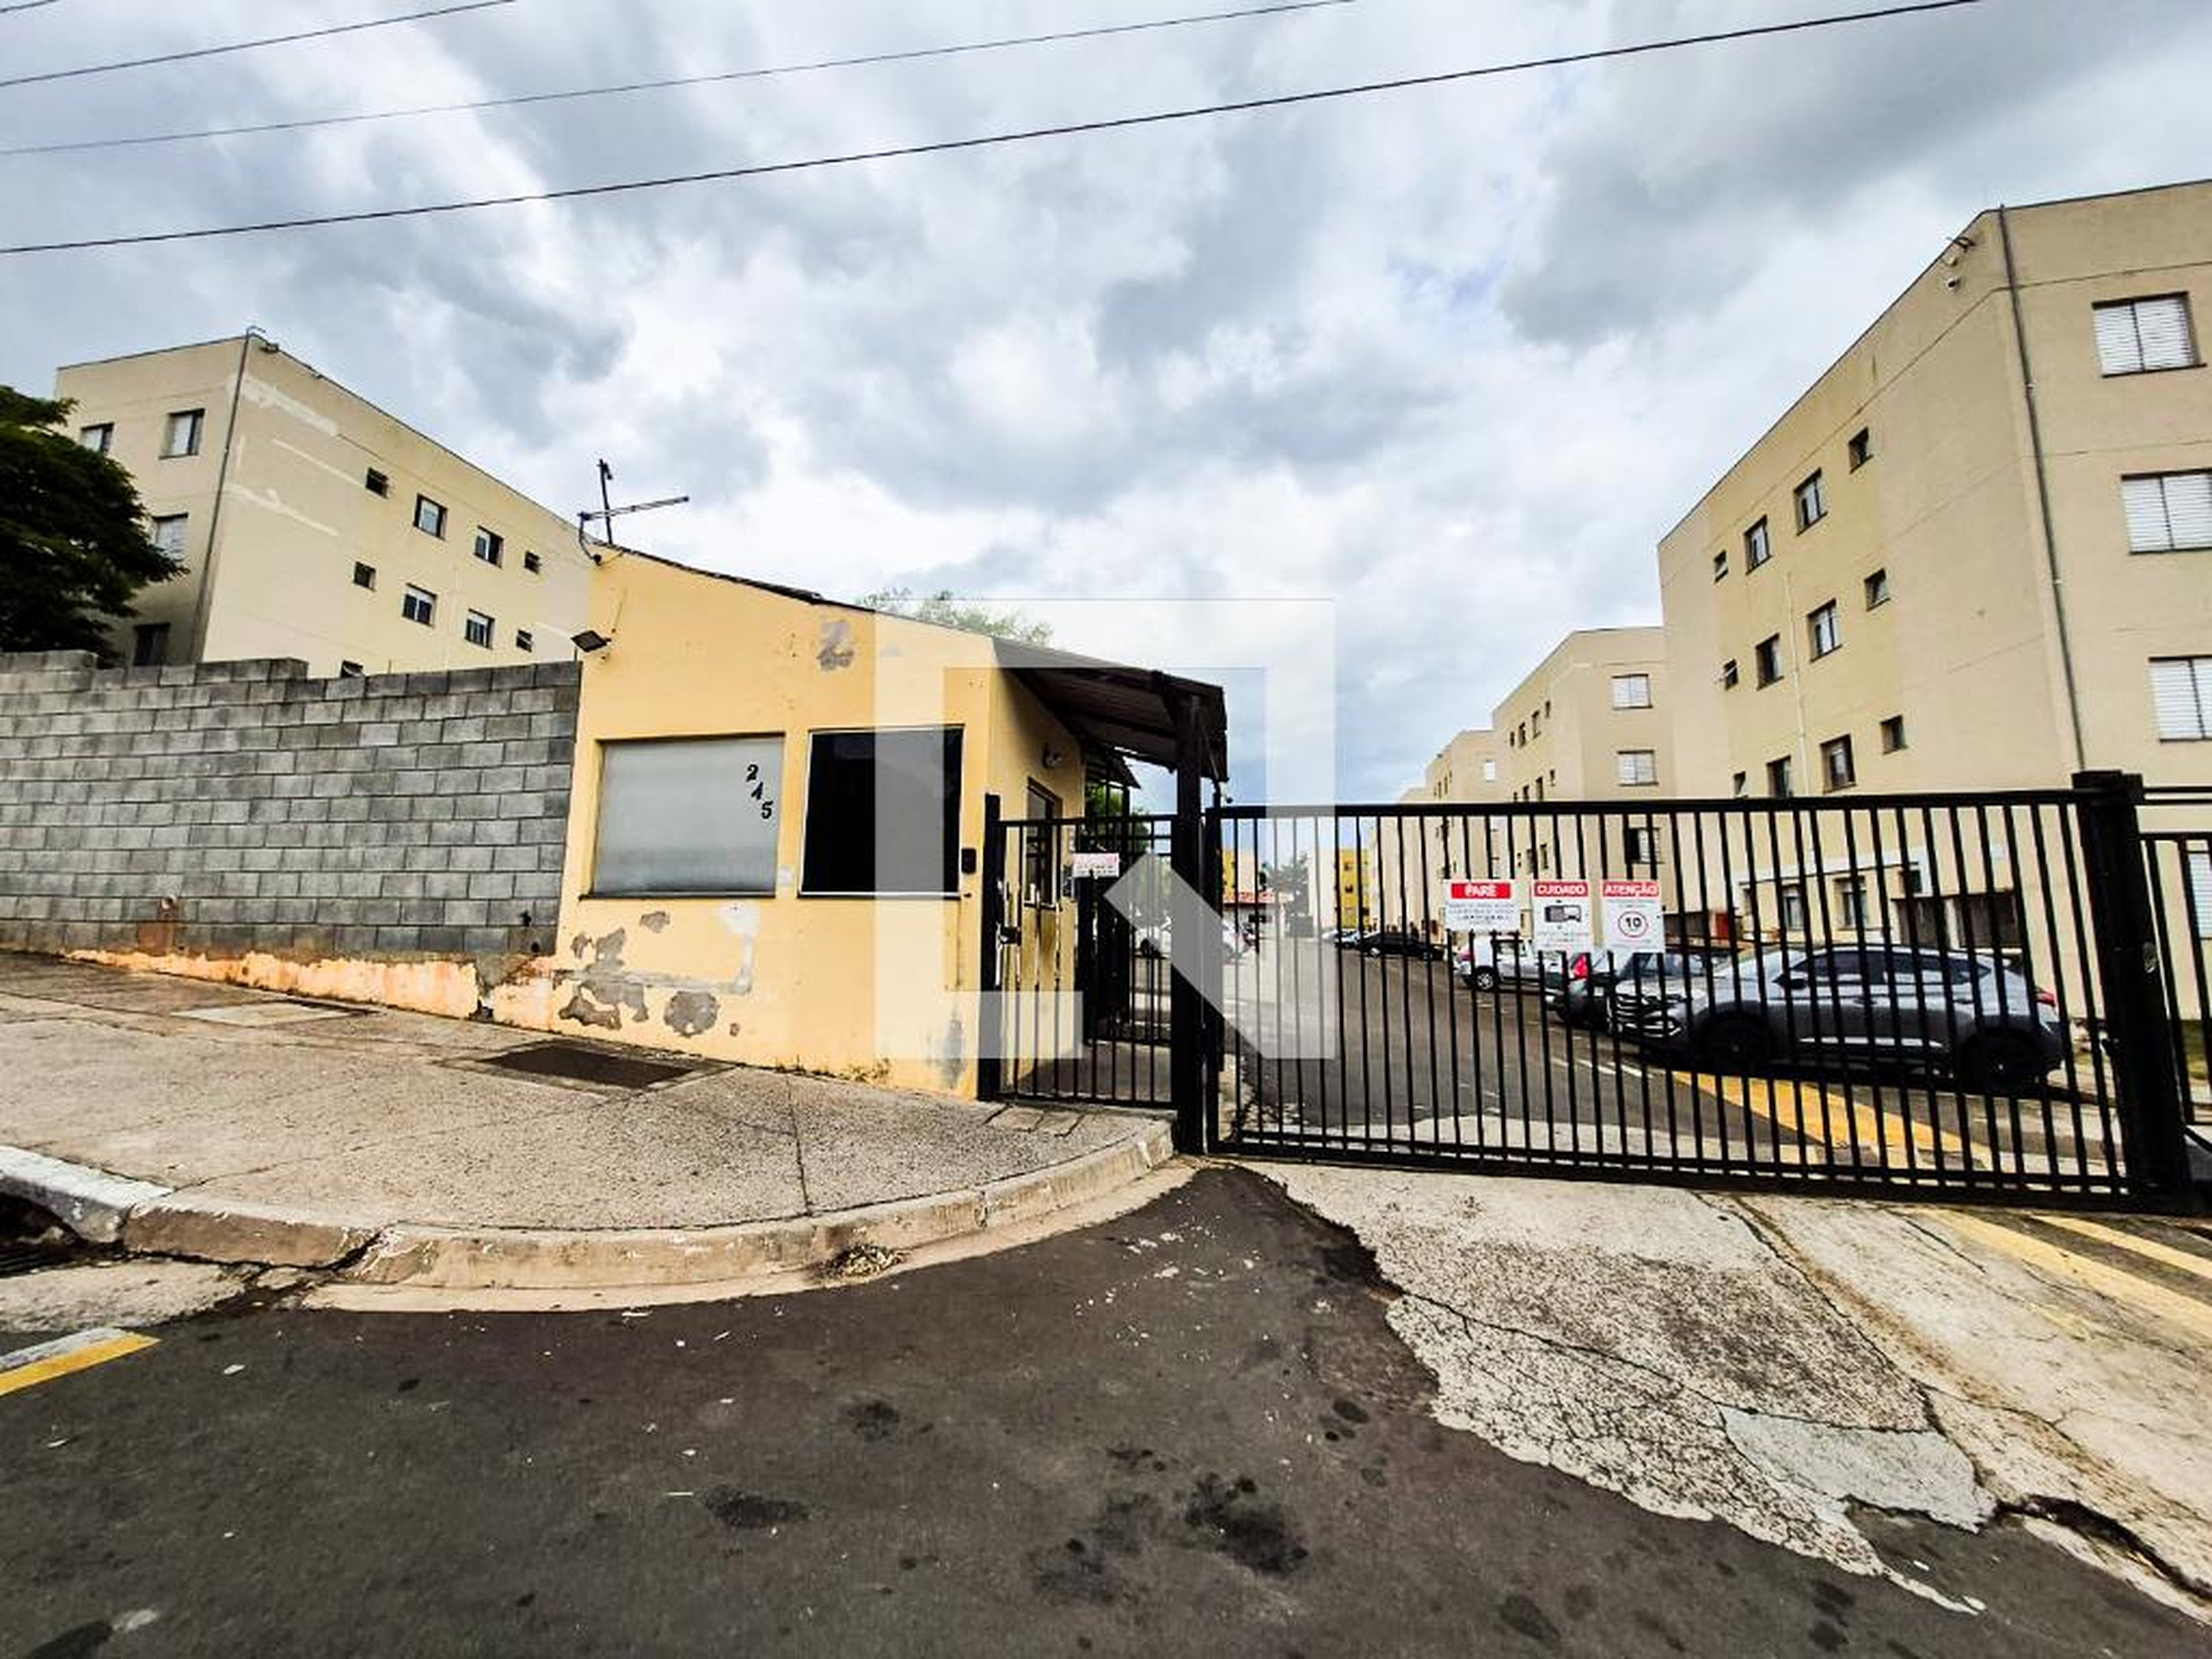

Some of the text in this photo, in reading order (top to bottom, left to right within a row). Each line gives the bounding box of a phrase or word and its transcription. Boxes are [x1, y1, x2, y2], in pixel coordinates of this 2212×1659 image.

[1464, 884, 1498, 897] PARE
[1537, 884, 1586, 896] CUIDADO
[1604, 882, 1658, 898] ATENÇÃO
[1626, 916, 1643, 928] 10
